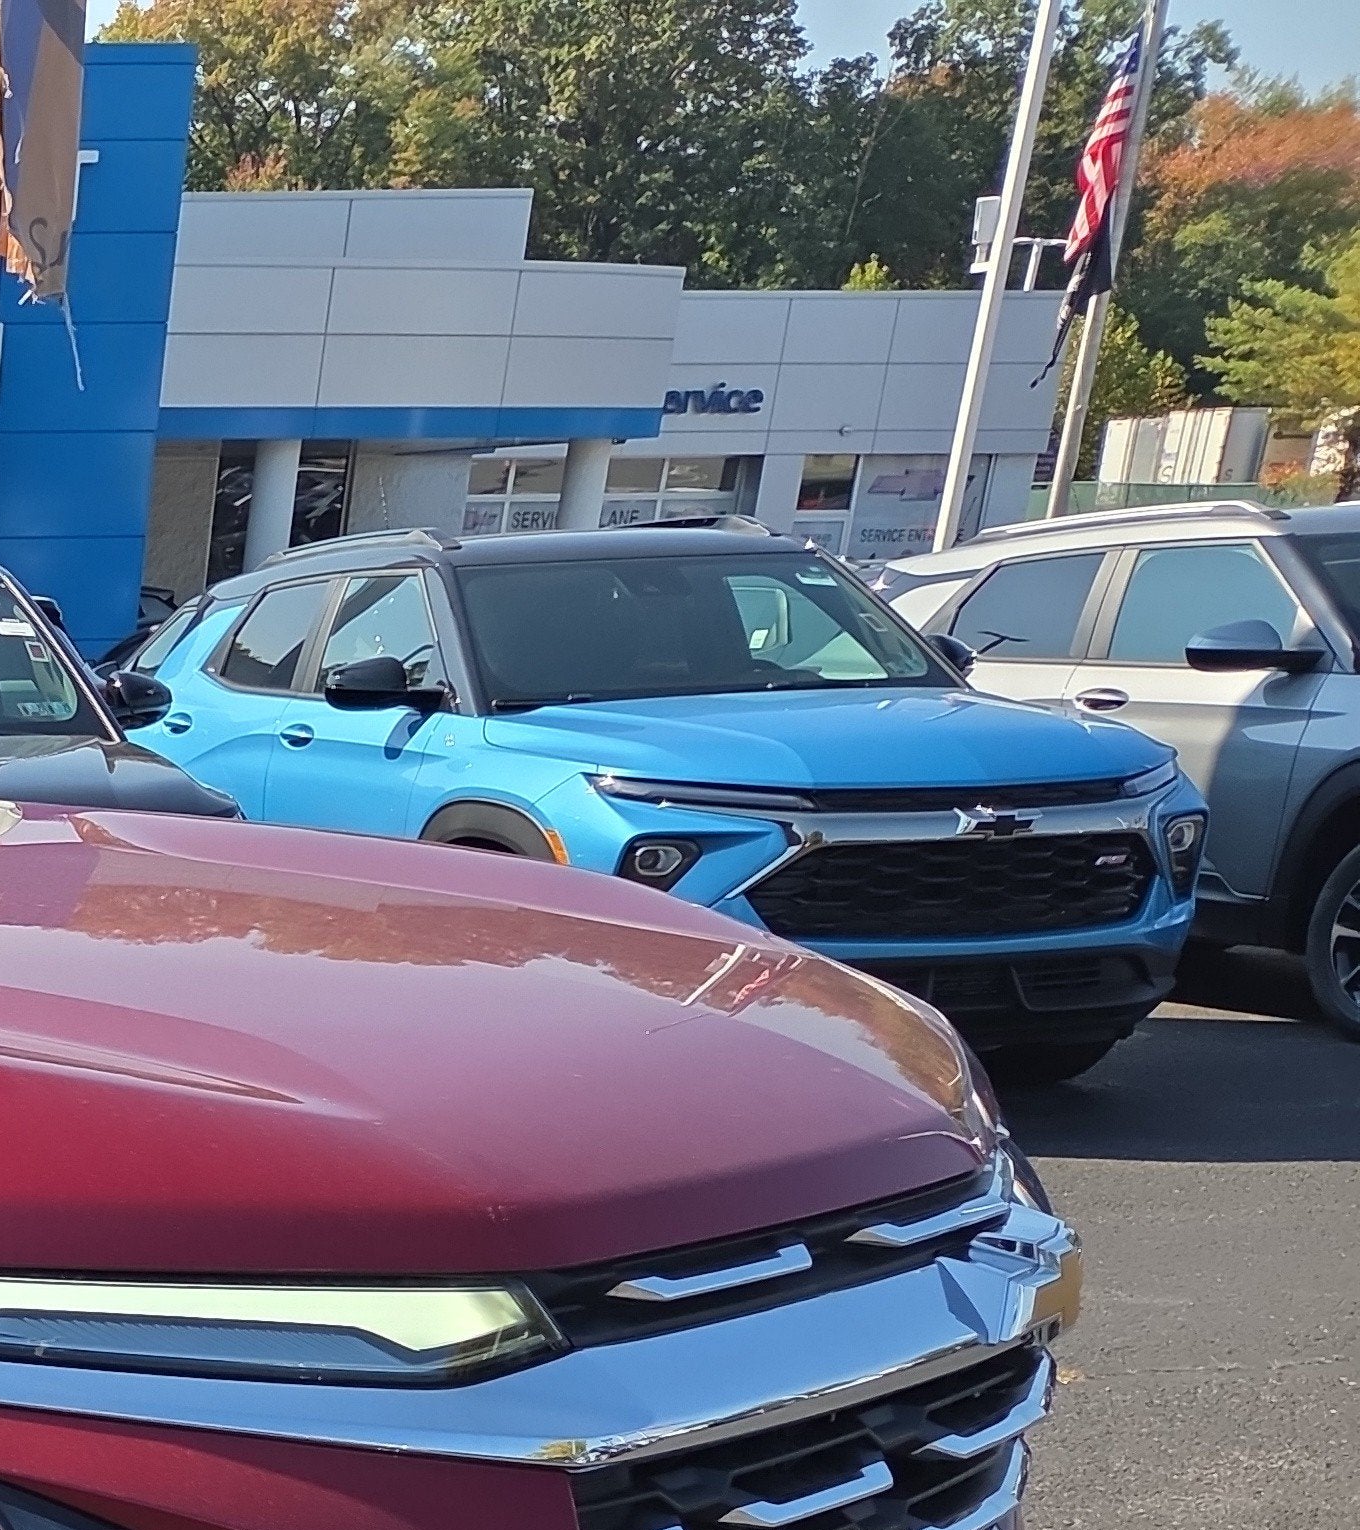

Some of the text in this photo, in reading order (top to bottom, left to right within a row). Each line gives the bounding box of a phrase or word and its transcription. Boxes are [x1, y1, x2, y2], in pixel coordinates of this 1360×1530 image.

[662, 381, 765, 415] ervice
[511, 510, 558, 529] SERVI
[860, 528, 965, 543] SERVICE ENTRE
